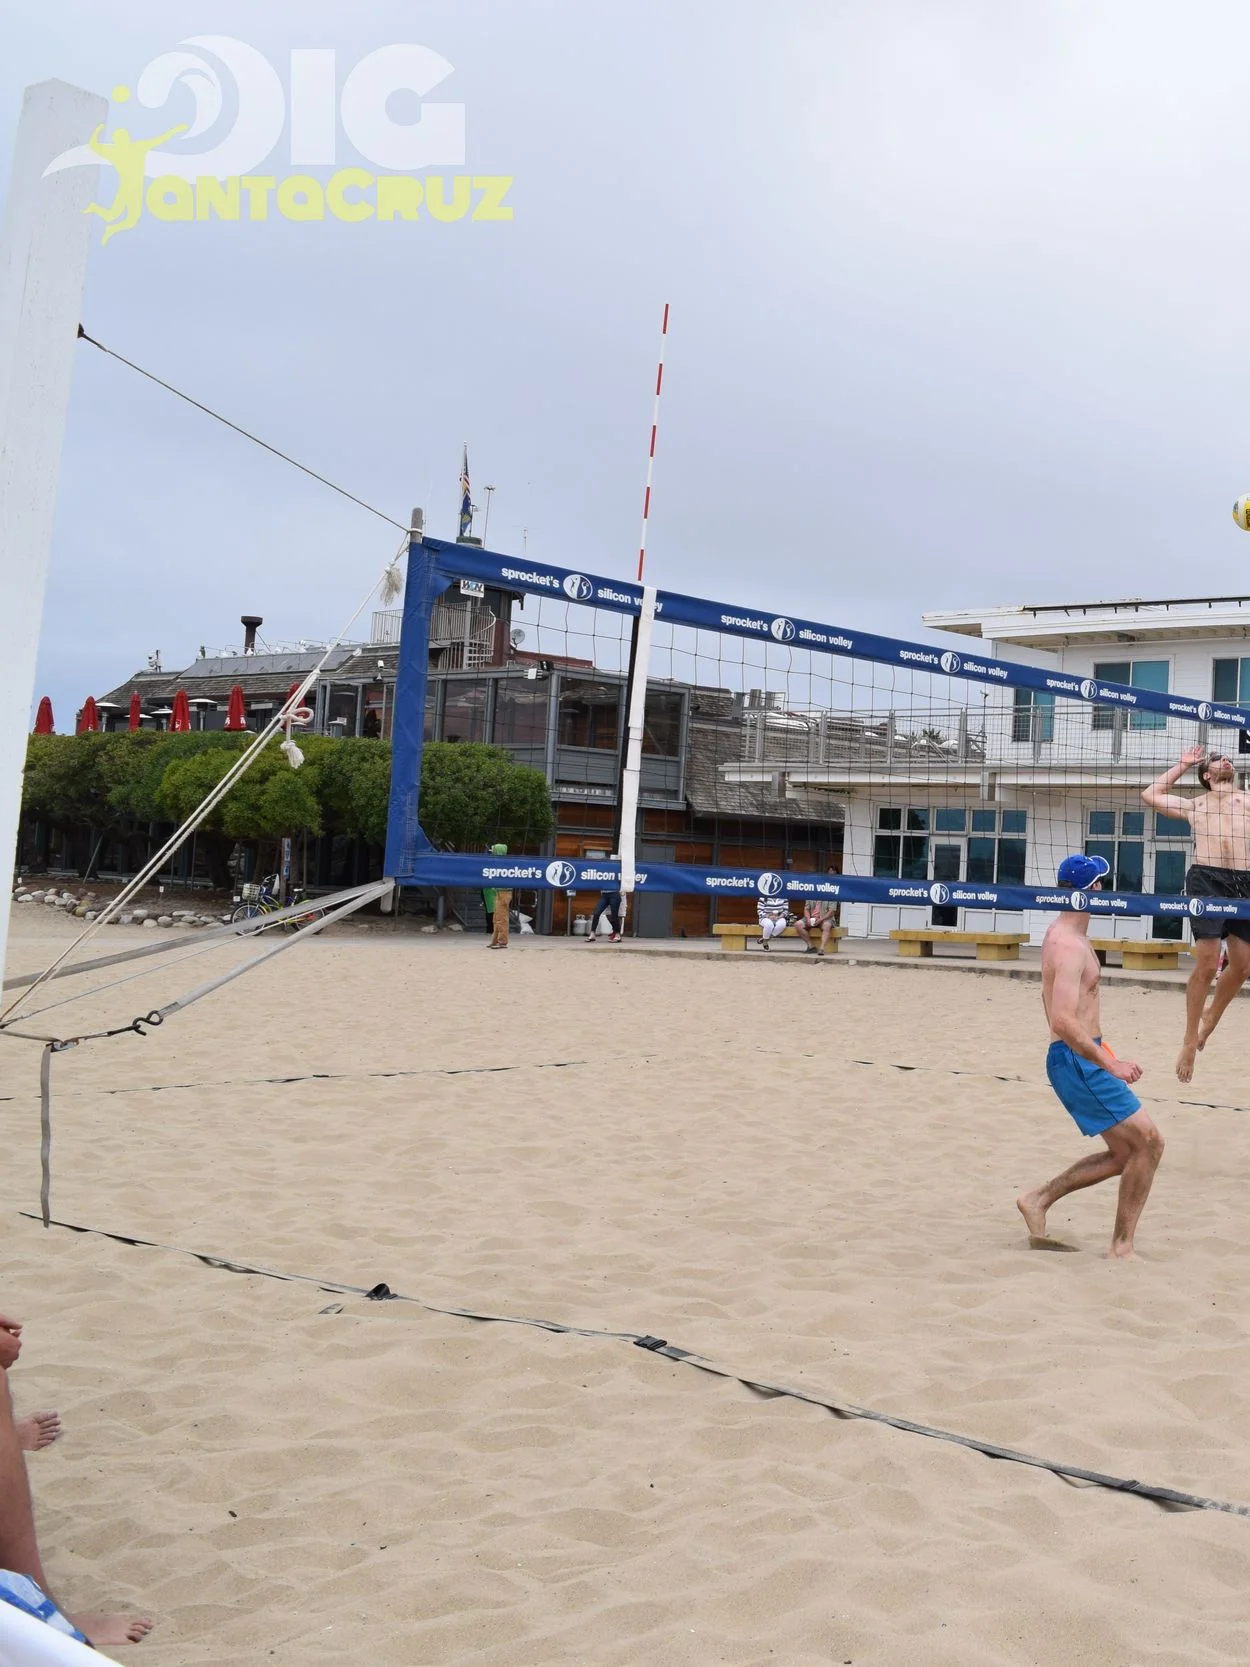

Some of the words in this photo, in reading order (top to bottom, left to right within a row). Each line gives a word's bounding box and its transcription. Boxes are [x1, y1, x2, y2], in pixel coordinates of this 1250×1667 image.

[501, 566, 560, 588] sprocket's
[598, 588, 631, 604] silicon
[721, 613, 768, 632] sprocket's
[799, 629, 827, 642] silicon
[829, 636, 852, 649] volley
[900, 651, 938, 664] sprocket's
[964, 662, 986, 673] silicon
[988, 667, 1008, 679] volley
[1047, 679, 1079, 691] sprocket's
[1100, 688, 1119, 699] silicon
[1120, 693, 1136, 703] volley
[1170, 703, 1197, 713] sprocket's
[1214, 710, 1230, 719] silicon
[1231, 714, 1245, 724] volley
[483, 867, 542, 879] sprocket's
[581, 869, 615, 880] silicon
[706, 877, 754, 887] sprocket's
[787, 881, 814, 891] silicon
[816, 883, 839, 894] volley
[889, 888, 928, 897] sprocket's
[953, 890, 976, 899] silicon
[977, 892, 997, 902] volley
[1036, 895, 1069, 904] sprocket's
[1090, 898, 1108, 906] silicon
[1108, 899, 1127, 908] volley
[1160, 902, 1187, 910] sprocket's
[1223, 905, 1237, 914] volley
